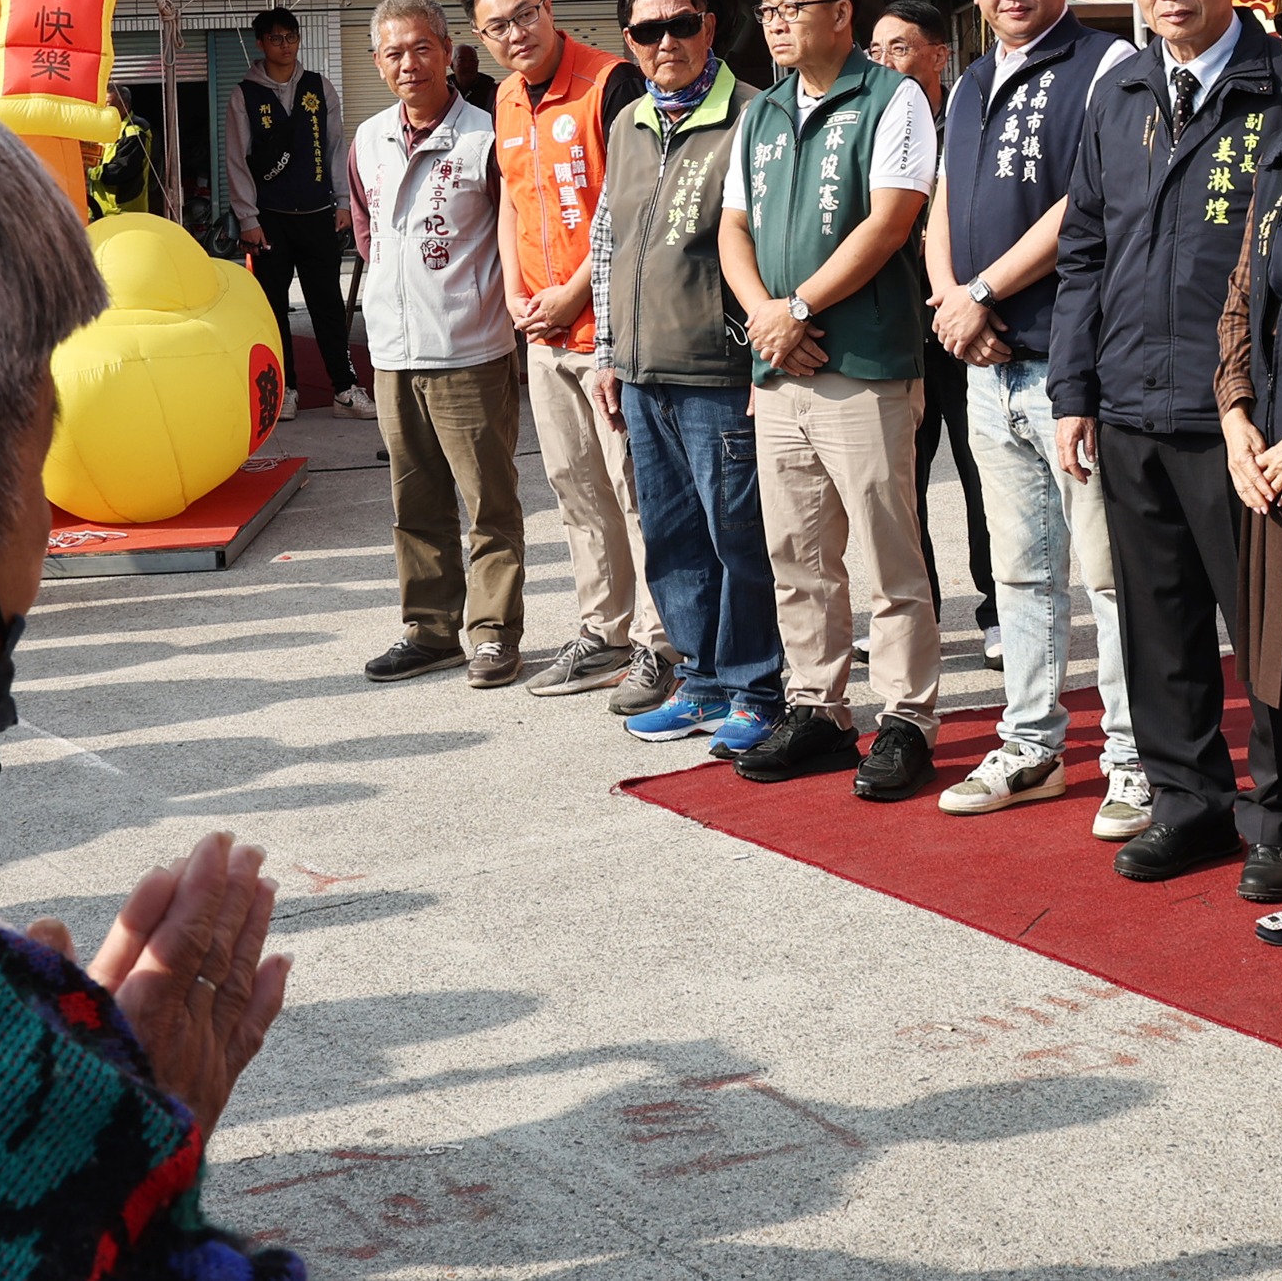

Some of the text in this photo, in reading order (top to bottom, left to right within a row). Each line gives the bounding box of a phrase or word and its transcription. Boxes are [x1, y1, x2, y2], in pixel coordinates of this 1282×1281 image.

[995, 83, 1029, 179] 吳禹寰
[1021, 70, 1056, 184] 台南市議員
[1239, 112, 1265, 174] 副市長
[263, 151, 291, 181] adidas
[423, 158, 454, 236] 陳亭妃
[553, 162, 583, 230] 陳皇宇
[569, 144, 588, 190] 市議員
[1204, 136, 1237, 225] 姜淋煌
